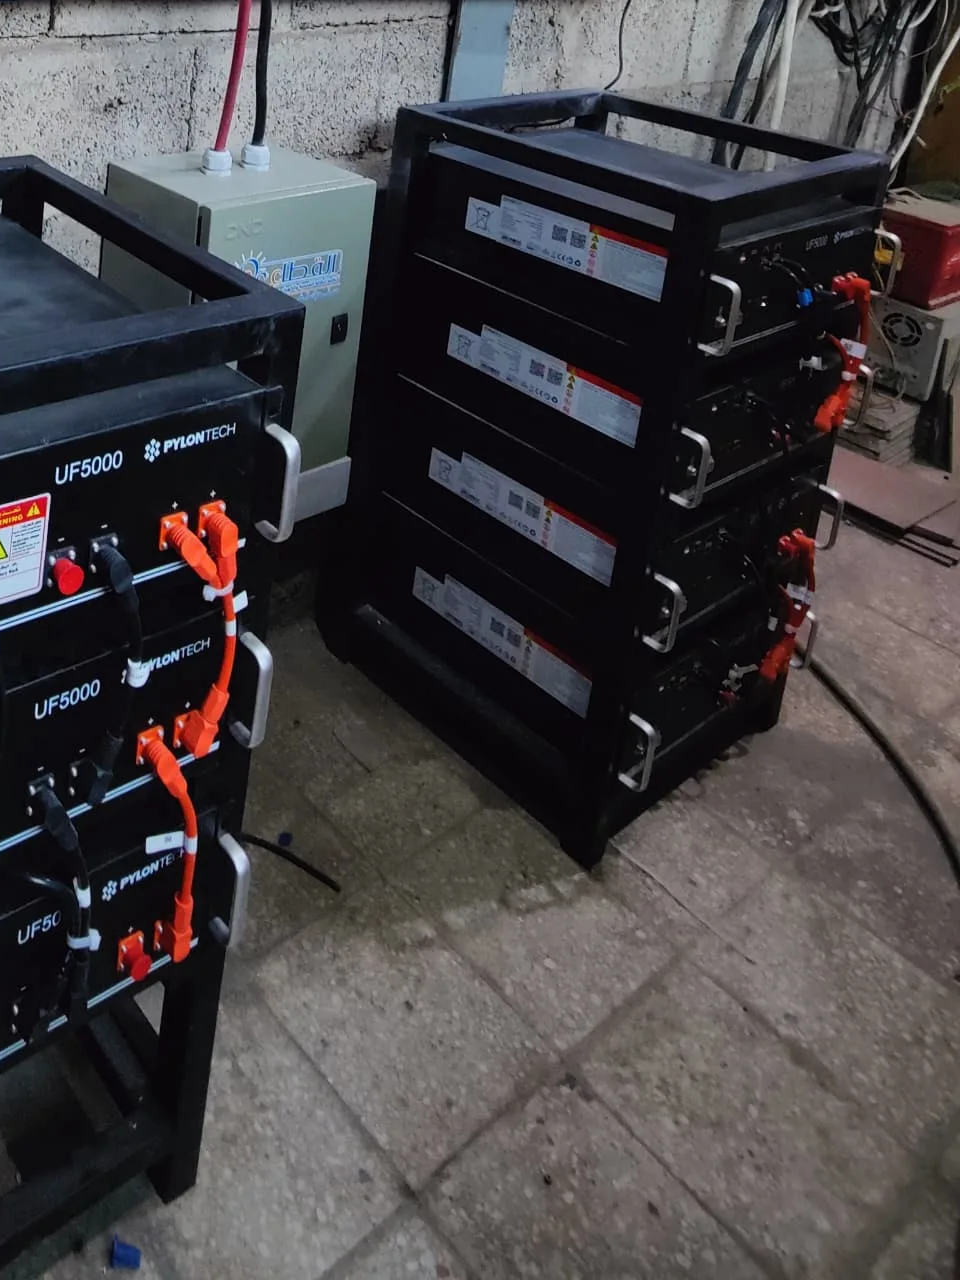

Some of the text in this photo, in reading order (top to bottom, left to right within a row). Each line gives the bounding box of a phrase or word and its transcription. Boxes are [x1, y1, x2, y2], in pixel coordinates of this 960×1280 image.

[163, 422, 237, 454] PYLONTECH
[55, 450, 124, 485] UF5000
[34, 679, 101, 720] UF5000
[120, 847, 185, 890] PYLONTE
[17, 910, 62, 945] UF50
